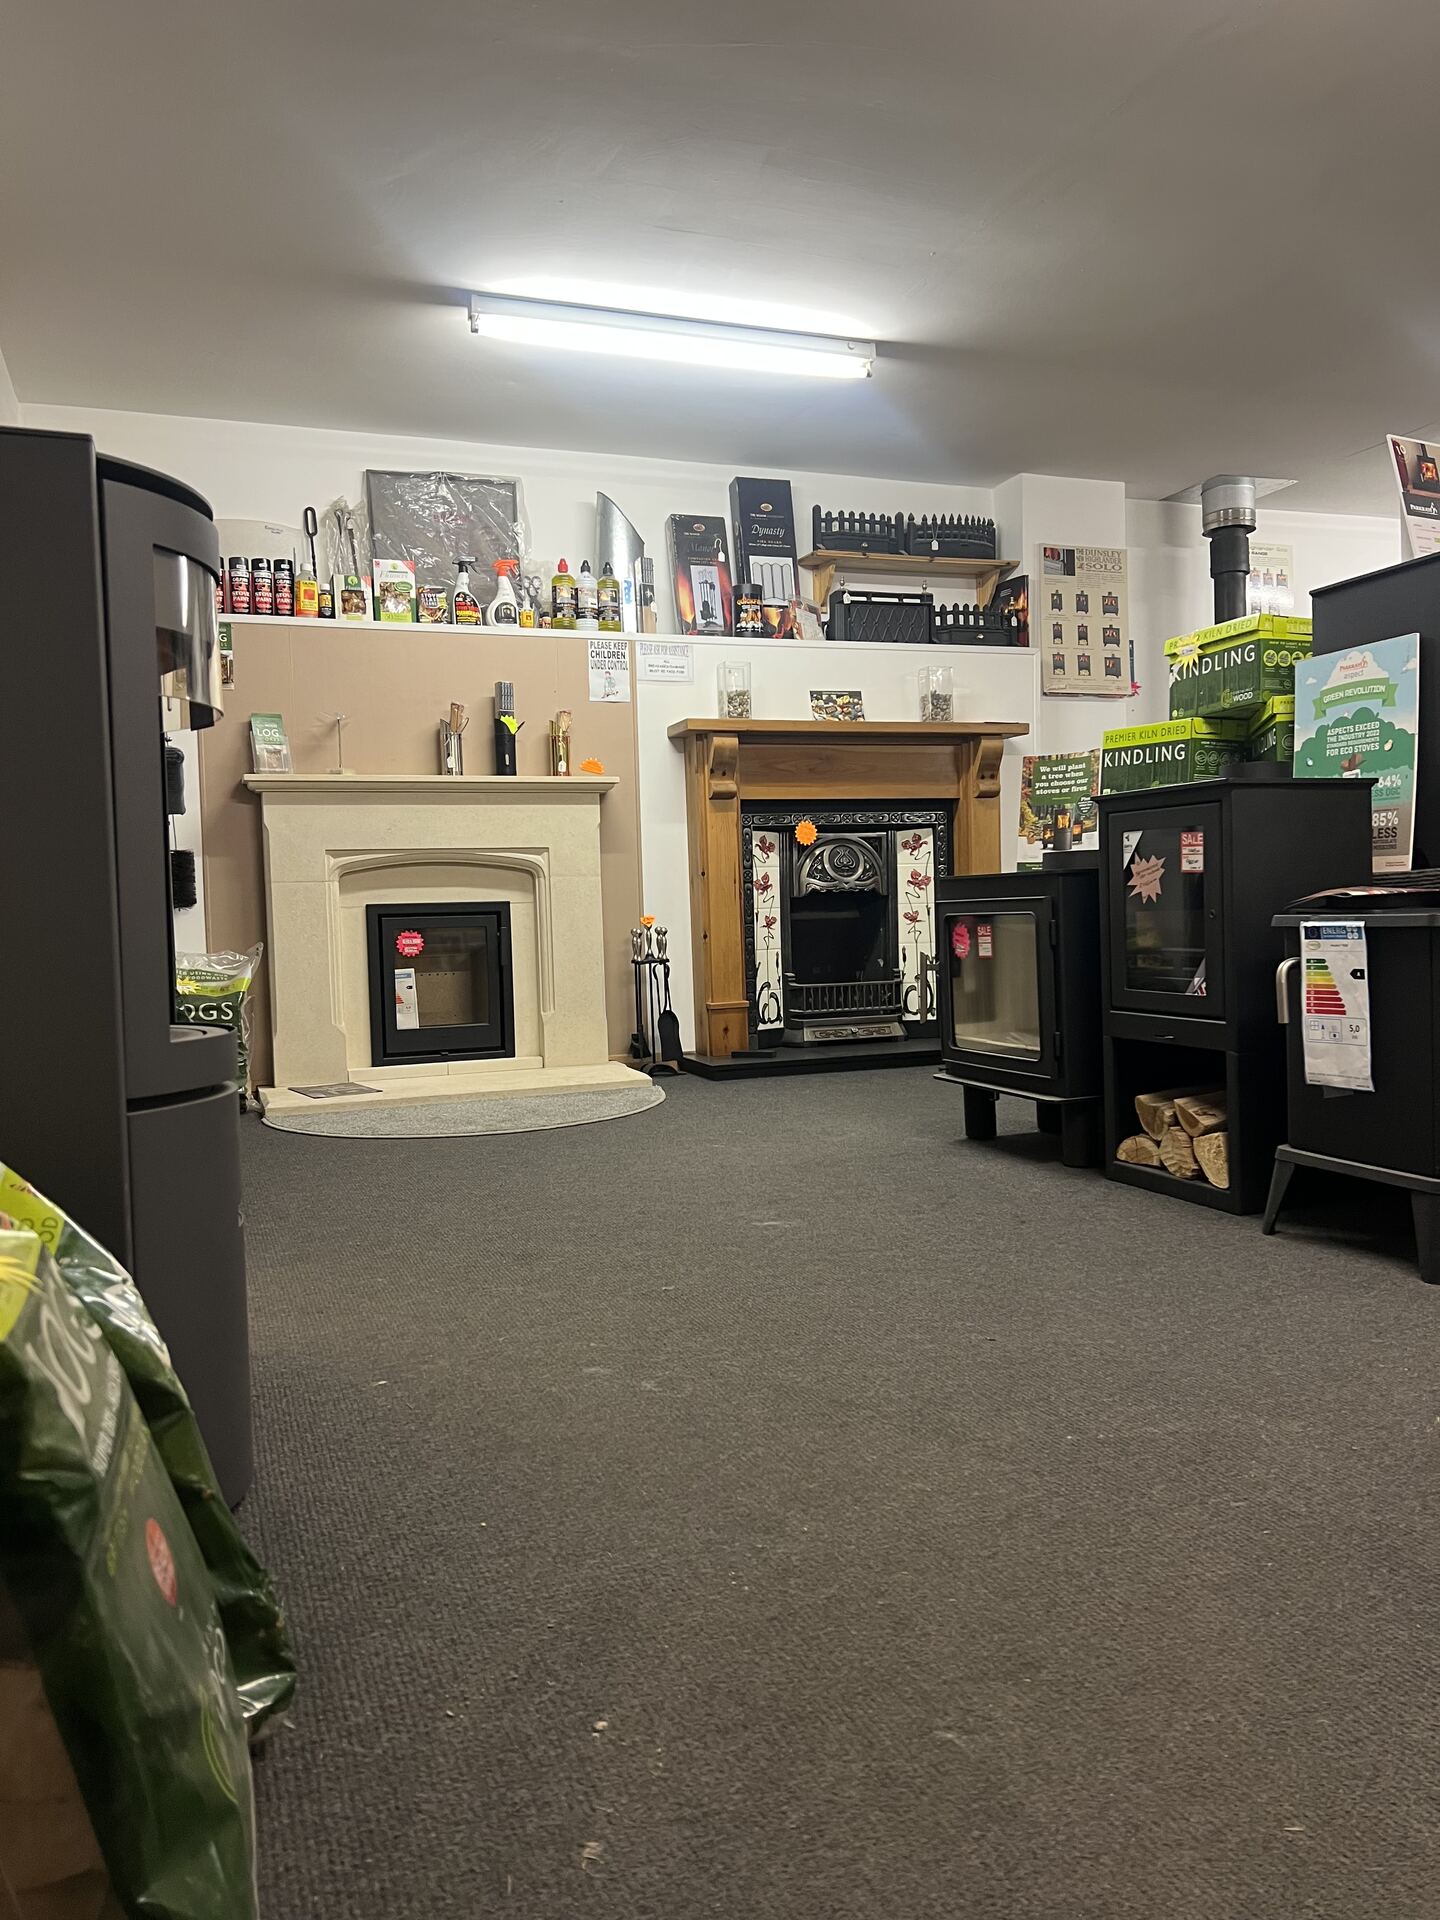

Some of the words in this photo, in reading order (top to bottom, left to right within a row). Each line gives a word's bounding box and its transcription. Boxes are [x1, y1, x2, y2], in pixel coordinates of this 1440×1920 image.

[751, 524, 786, 538] Dynasty
[1085, 562, 1122, 571] SOLO
[1203, 626, 1224, 641] KILN
[1225, 619, 1253, 634] DRIED
[590, 641, 612, 650] PLEASE
[613, 642, 628, 650] KEEP
[590, 650, 626, 660] CHILDREN
[591, 660, 606, 670] UNDER
[606, 660, 629, 670] CONTROL
[1172, 645, 1256, 681] KINDLING
[1232, 692, 1254, 701] WOOD
[1323, 692, 1344, 703] GREEN
[1344, 684, 1386, 698] REVOLUTION
[256, 728, 280, 737] LOG
[1327, 725, 1354, 736] ASPECTS
[1355, 721, 1380, 731] EXCEED
[1105, 731, 1136, 743] PREMIER
[1139, 729, 1158, 740] KILN
[1160, 726, 1187, 737] DRIED
[1326, 749, 1340, 757] FOR
[1340, 746, 1354, 755] ECO
[1354, 743, 1380, 753] STOVES
[1104, 744, 1186, 768] KINDLING
[1053, 764, 1066, 772] will
[1068, 763, 1086, 772] plant
[1050, 779, 1075, 787] choose
[1035, 787, 1060, 795] stoves
[1371, 811, 1399, 827] 85%
[1372, 827, 1398, 839] LESS
[1182, 834, 1204, 845] SALE
[977, 926, 992, 936] SALE
[184, 1002, 233, 1021] OGS
